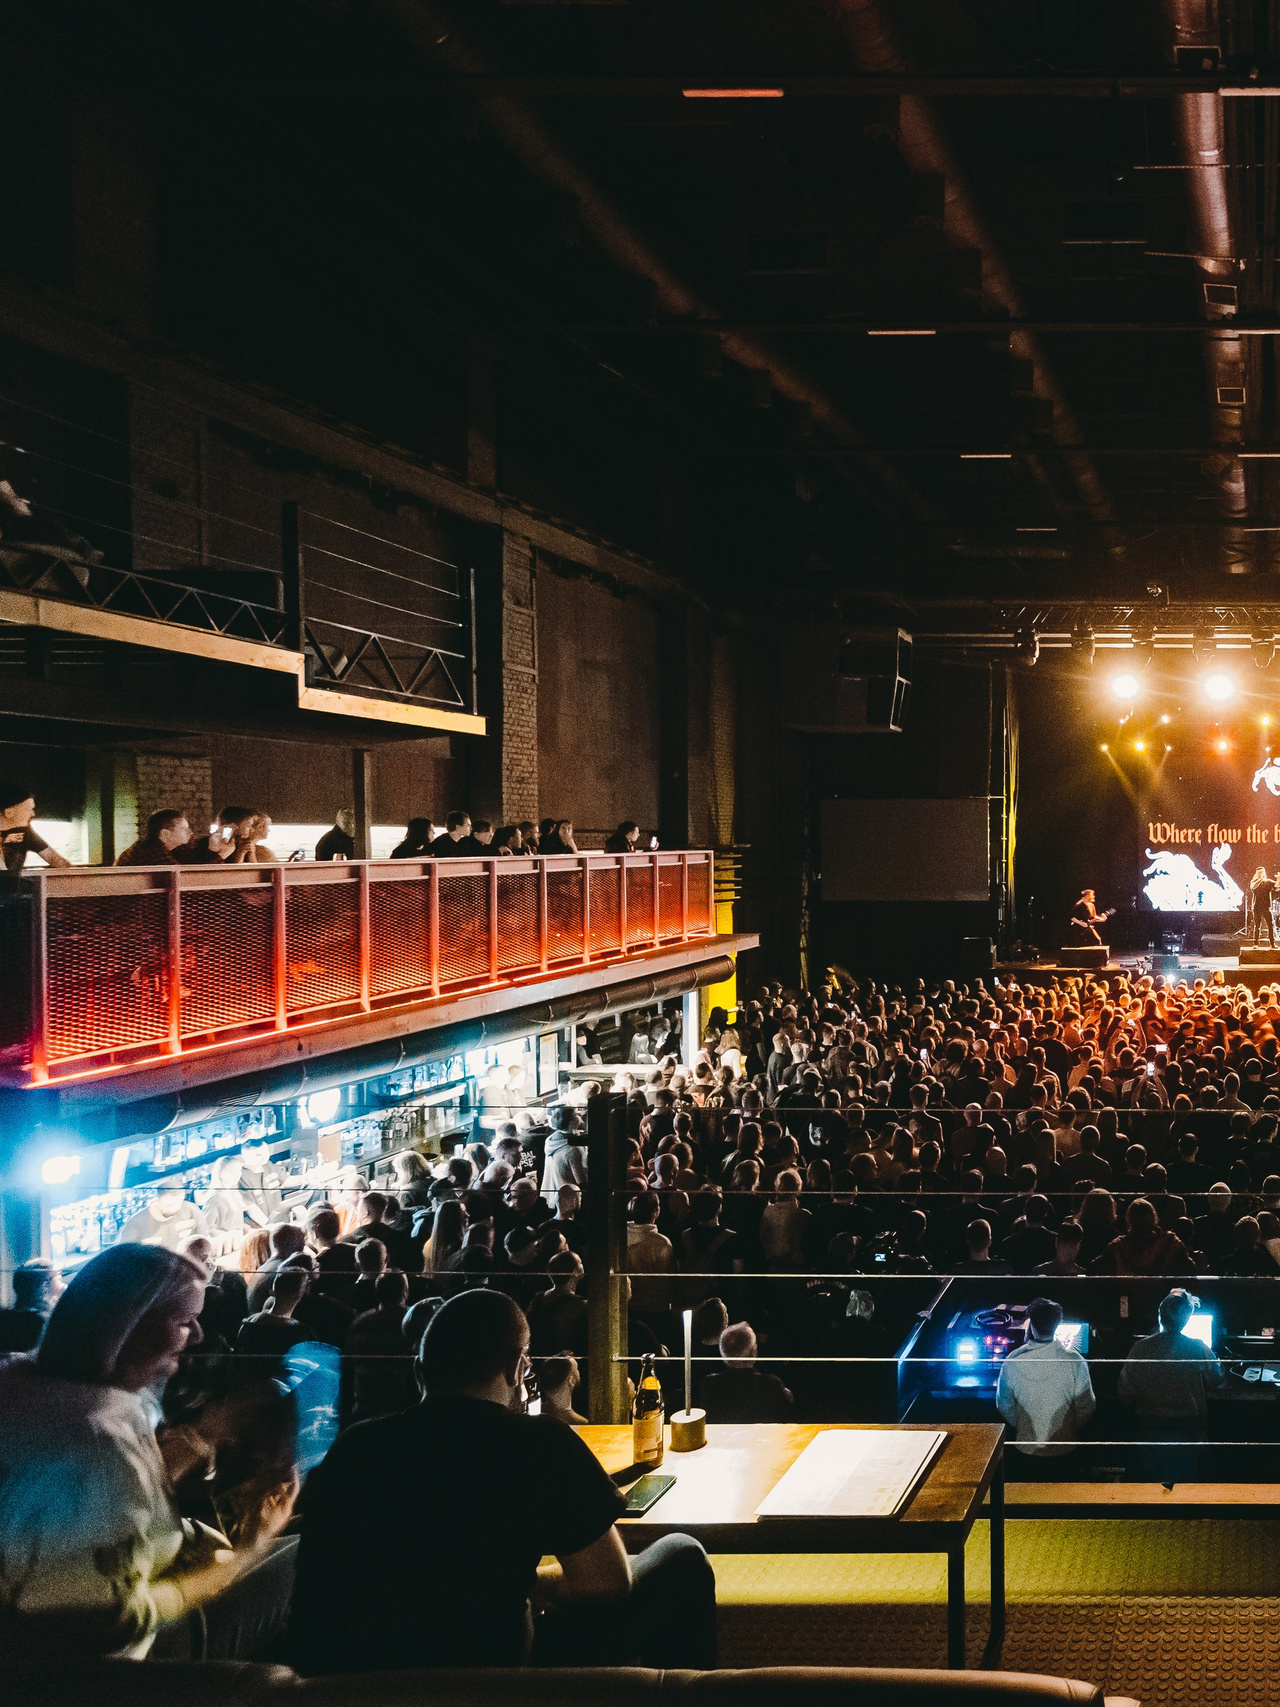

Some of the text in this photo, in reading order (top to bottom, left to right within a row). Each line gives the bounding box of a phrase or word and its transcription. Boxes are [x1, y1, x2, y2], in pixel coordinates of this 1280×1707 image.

[1148, 822, 1202, 844] Where
[1207, 823, 1242, 844] flow
[1246, 823, 1269, 844] the
